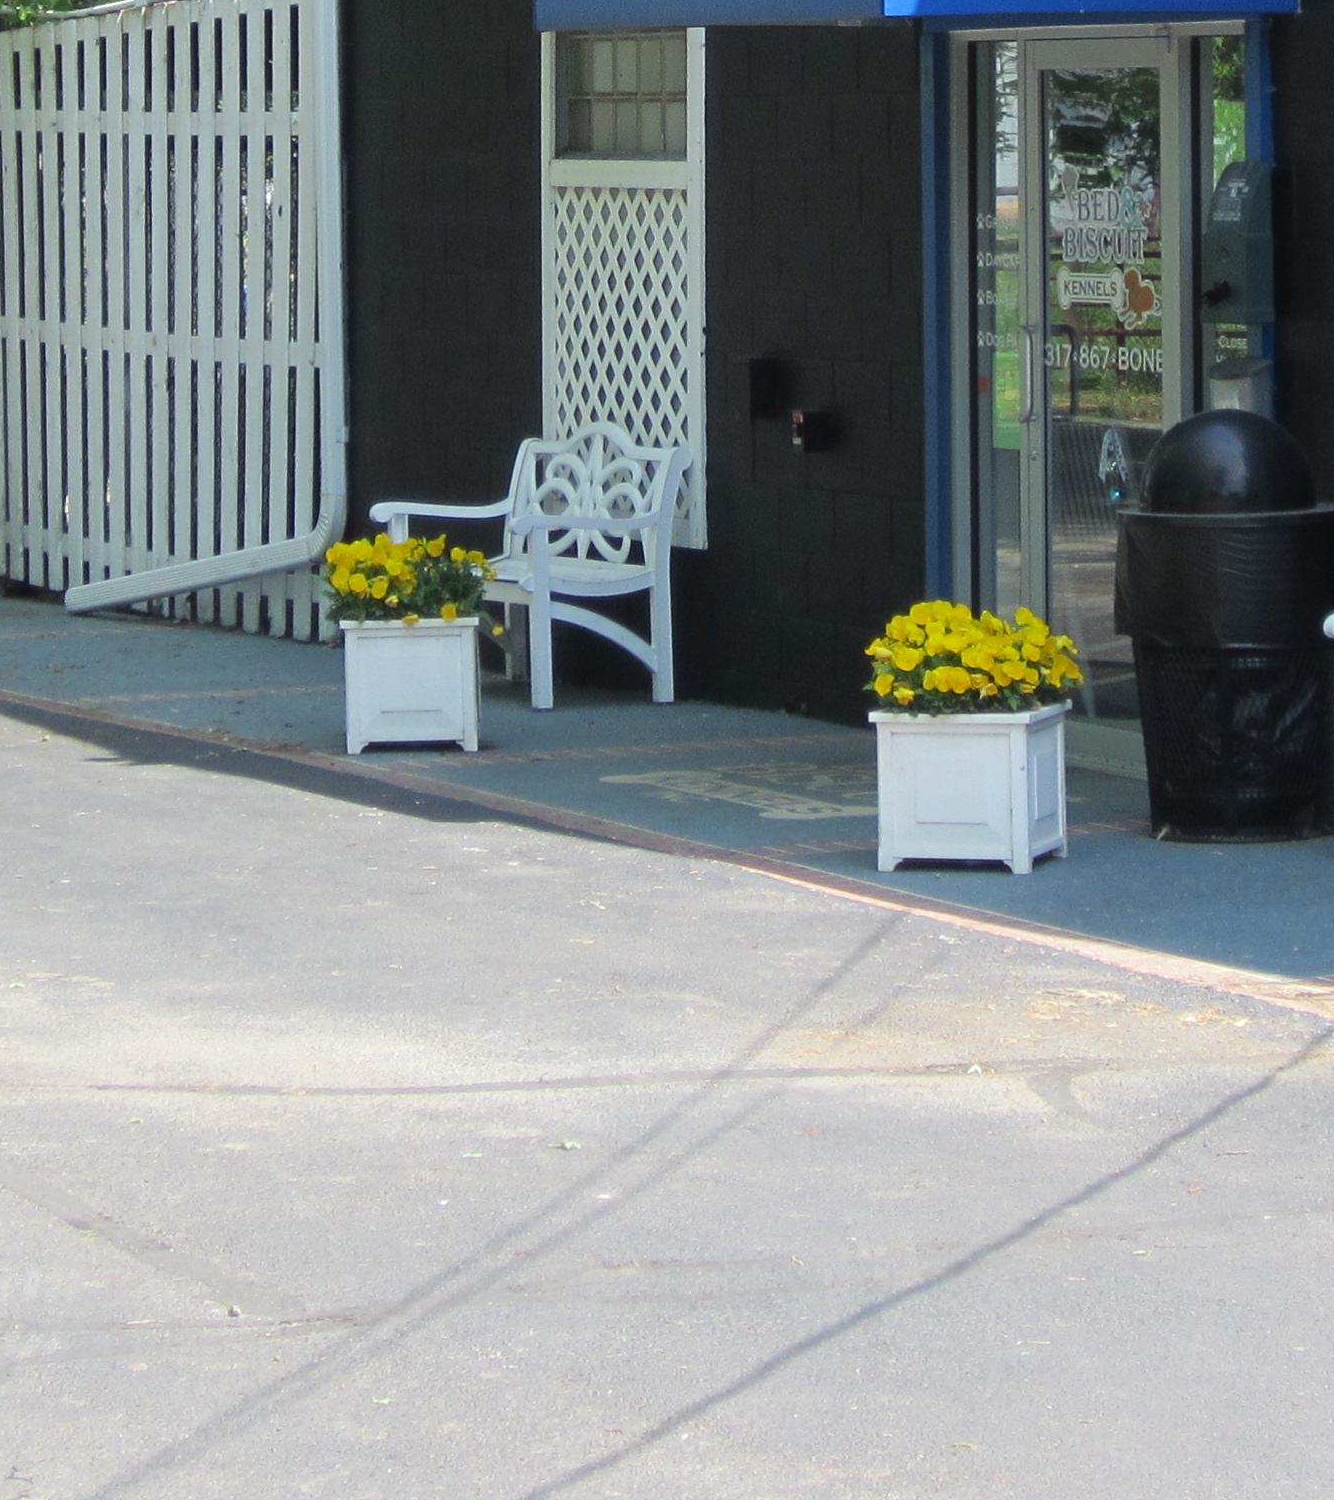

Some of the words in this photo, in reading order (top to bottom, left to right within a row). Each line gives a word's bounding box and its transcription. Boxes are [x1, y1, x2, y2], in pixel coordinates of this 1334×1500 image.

[1077, 189, 1120, 221] BED
[1063, 228, 1146, 262] BISCUIT
[1063, 281, 1117, 297] KENNELS
